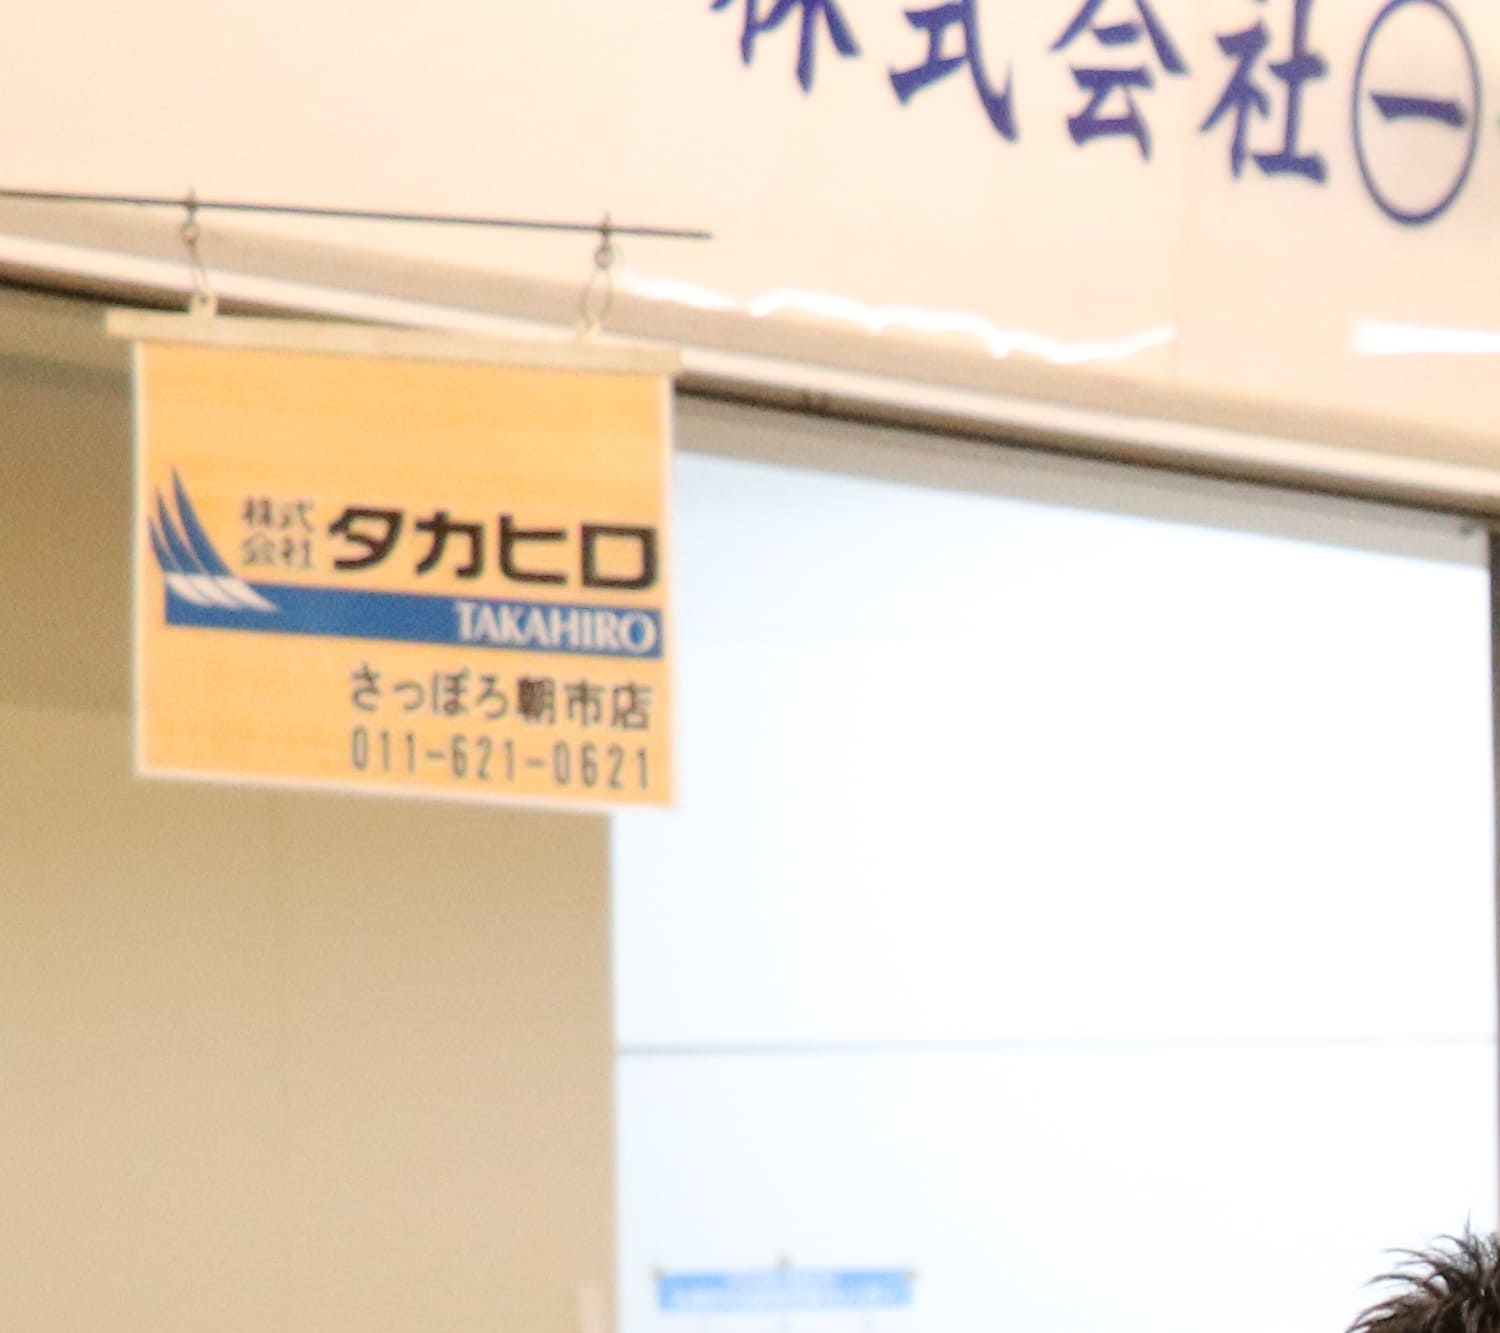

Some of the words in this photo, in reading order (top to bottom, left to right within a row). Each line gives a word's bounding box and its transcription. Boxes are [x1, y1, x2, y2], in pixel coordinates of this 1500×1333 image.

[240, 494, 316, 535] 株式
[327, 505, 660, 592] タカヒロ
[240, 535, 316, 571] 会社
[456, 600, 660, 655] TAKAHIRO
[349, 661, 652, 732] さっぽろ朝市店
[349, 727, 652, 791] 011-621-0621
